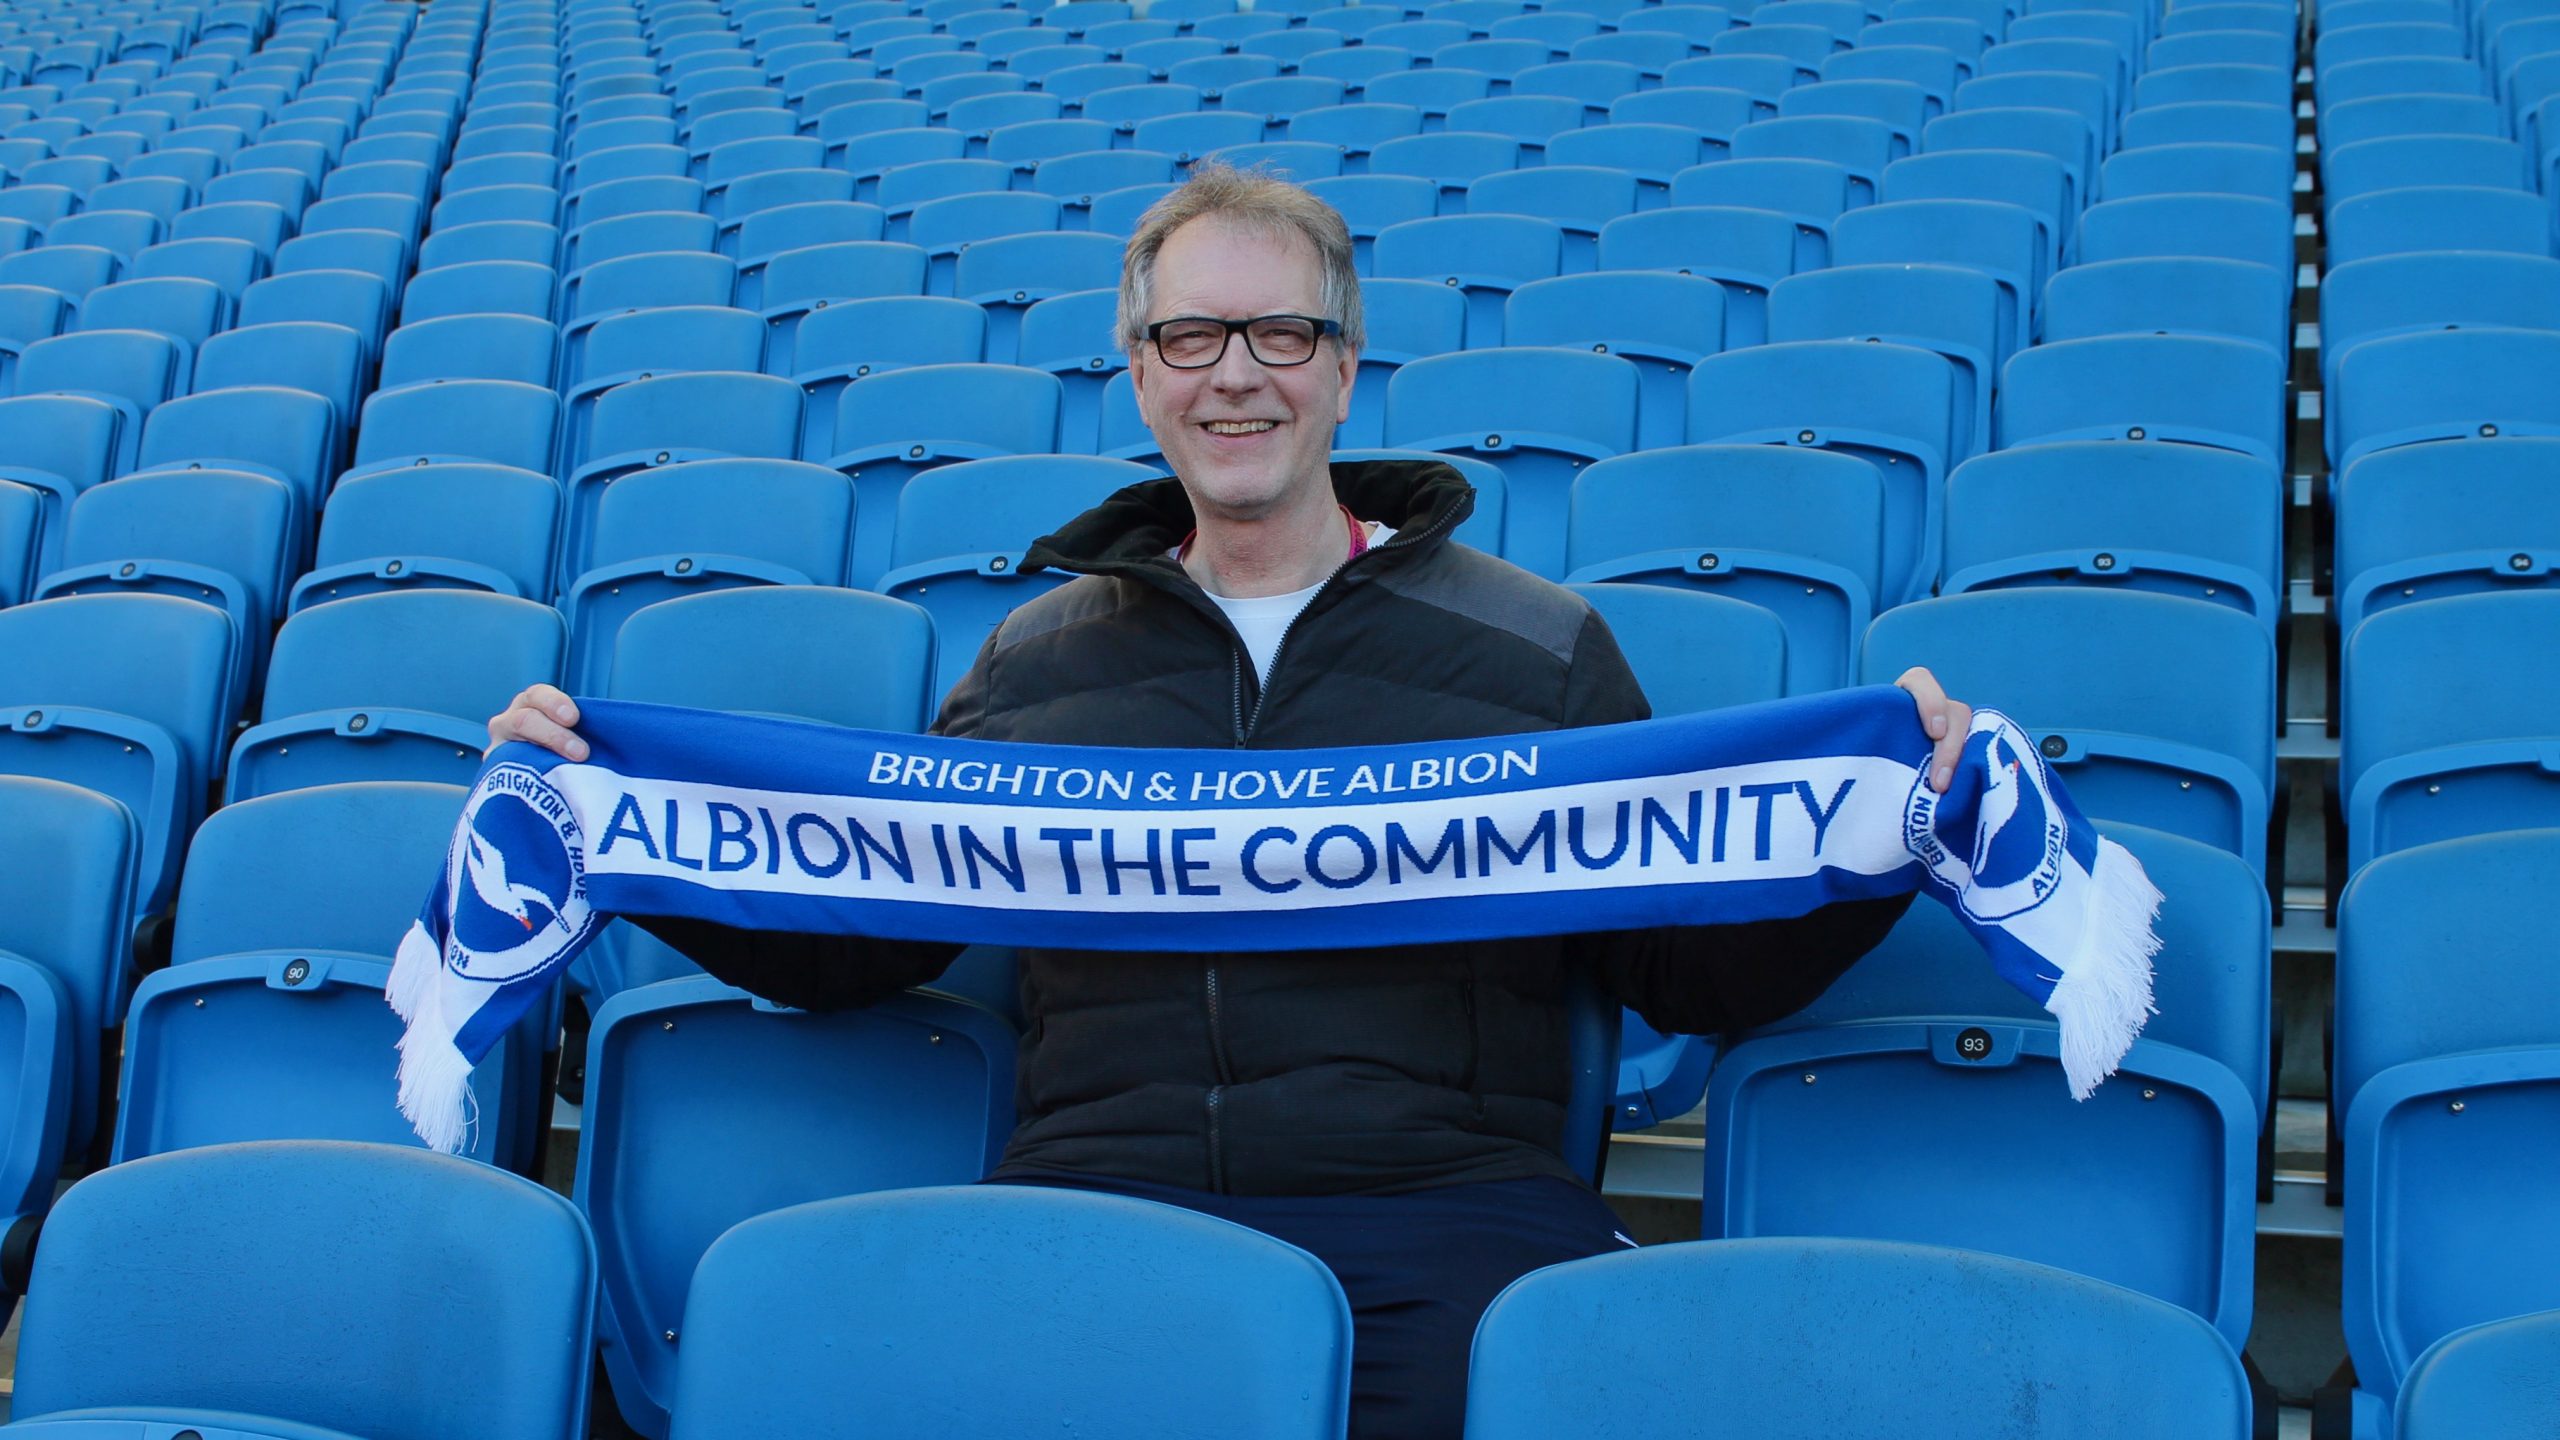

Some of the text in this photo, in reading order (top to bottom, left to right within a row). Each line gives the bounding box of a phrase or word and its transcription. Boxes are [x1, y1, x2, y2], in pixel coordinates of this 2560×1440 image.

[1702, 558, 1715, 567] 92
[2097, 558, 2112, 567] 93
[869, 746, 1538, 801] BRIGHTON & HOVE ALBION
[488, 772, 564, 820] BRIGHTON
[561, 821, 577, 841] &
[597, 779, 1856, 896] ALBION IN THE COMMUNITY
[2032, 823, 2061, 898] ALBION
[288, 967, 304, 979] 90
[1964, 1038, 1984, 1052] 93
